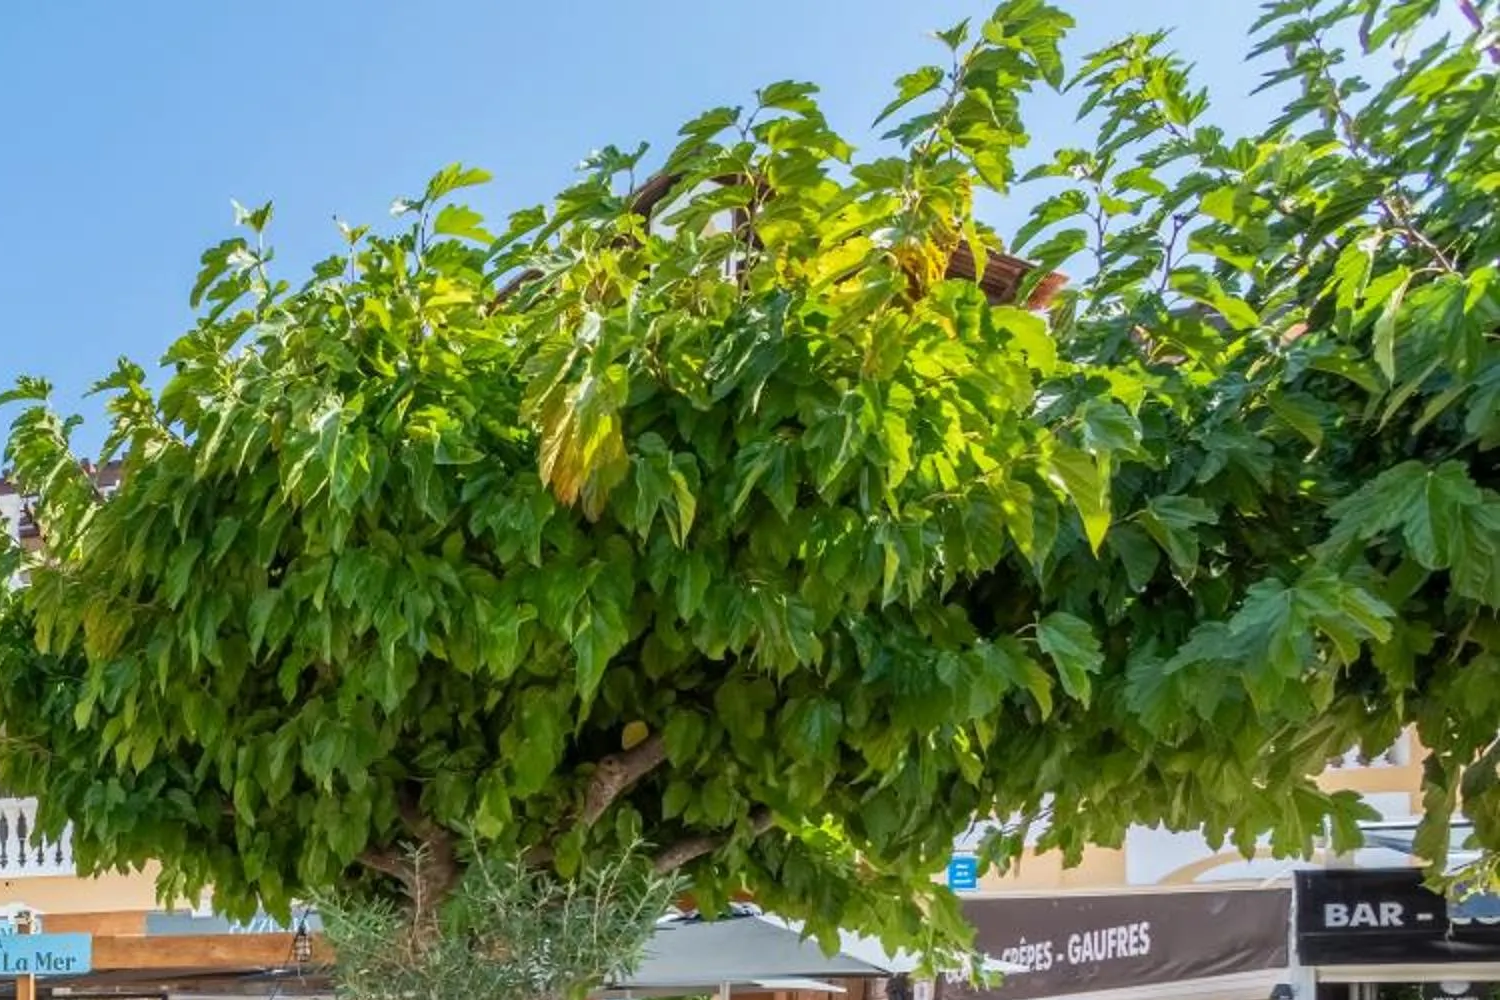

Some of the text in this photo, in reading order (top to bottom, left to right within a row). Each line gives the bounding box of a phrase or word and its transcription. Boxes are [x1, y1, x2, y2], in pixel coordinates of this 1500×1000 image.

[1324, 901, 1404, 928] BAR
[1067, 921, 1150, 965] GAUFRES
[2, 954, 28, 972] La
[34, 951, 76, 971] Mer
